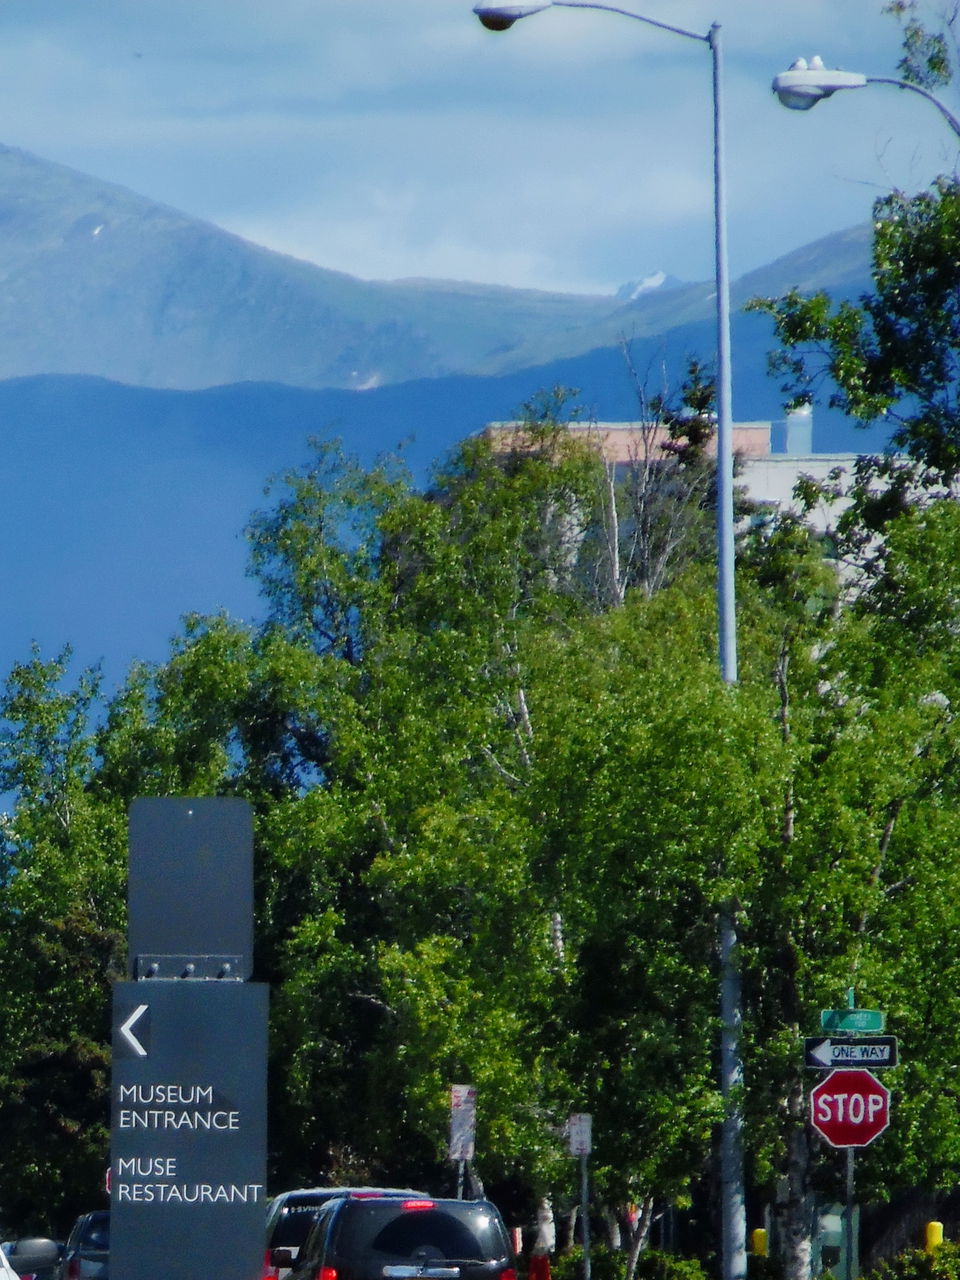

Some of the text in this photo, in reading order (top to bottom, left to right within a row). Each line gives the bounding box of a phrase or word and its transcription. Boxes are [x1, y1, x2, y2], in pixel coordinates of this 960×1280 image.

[832, 1046, 887, 1059] ONE WAY
[119, 1084, 214, 1104] MUSEUM
[818, 1093, 883, 1124] STOP
[119, 1110, 240, 1130] ENTRANCE
[118, 1157, 177, 1176] MUSE
[118, 1184, 263, 1203] RESTAURANT
